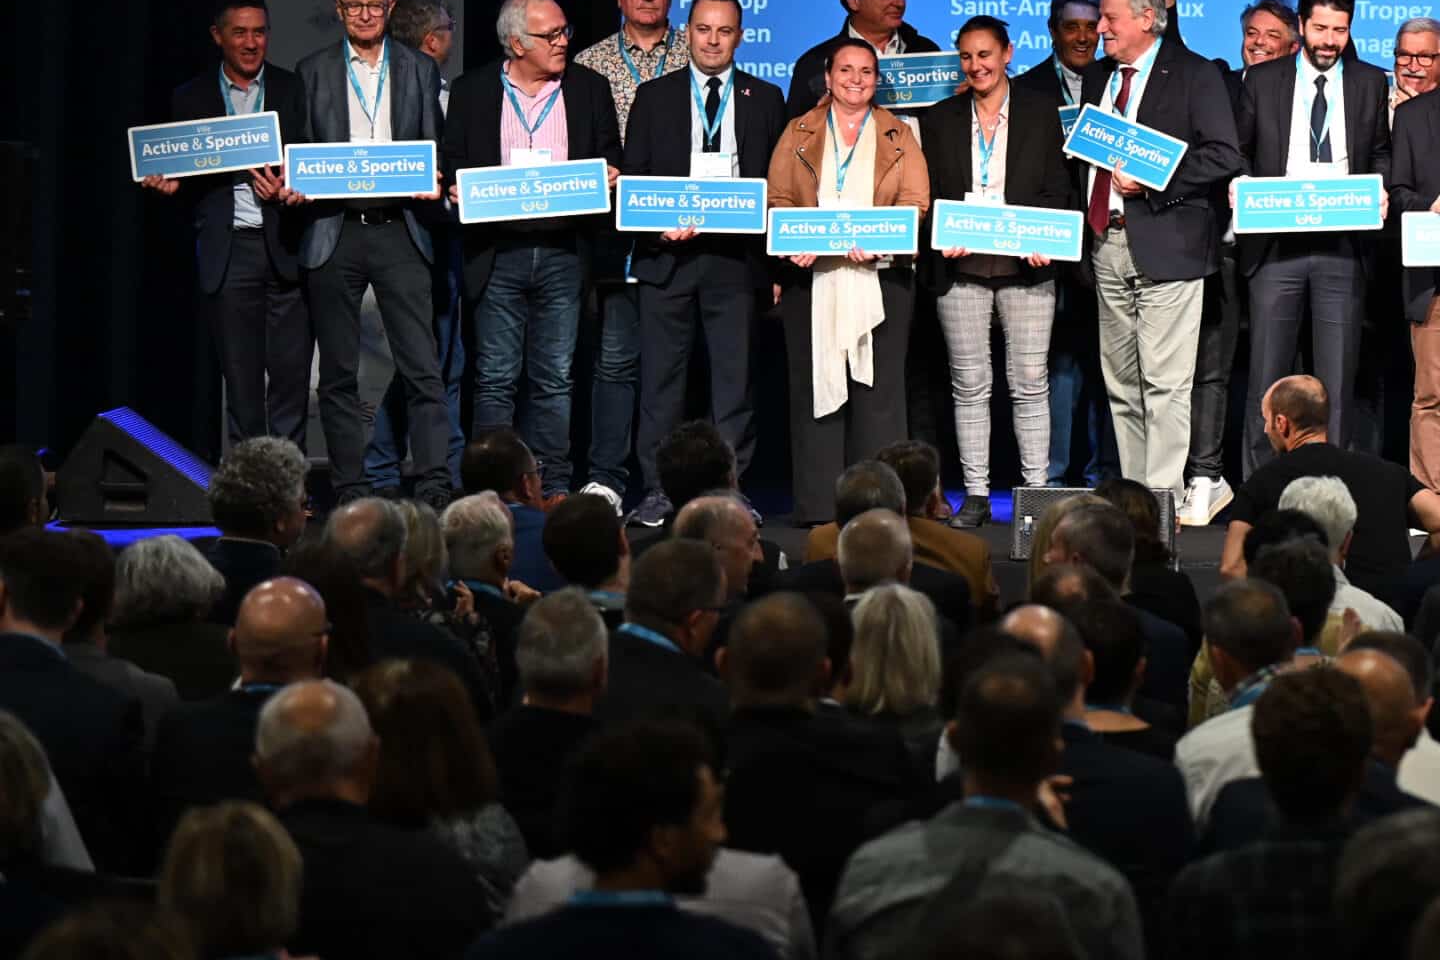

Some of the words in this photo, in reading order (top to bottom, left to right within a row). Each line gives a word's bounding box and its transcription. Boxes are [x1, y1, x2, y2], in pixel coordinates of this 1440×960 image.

[886, 70, 896, 84] &
[898, 67, 960, 87] Sportive
[142, 140, 189, 157] Active
[192, 137, 201, 151] &
[205, 130, 270, 154] Sportive
[1081, 122, 1116, 146] Active
[1116, 135, 1125, 149] &
[1125, 138, 1170, 167] Sportive
[297, 158, 344, 174] Active
[347, 159, 358, 173] &
[361, 158, 425, 177] Sportive
[470, 183, 518, 199] Active
[520, 182, 531, 195] &
[533, 177, 598, 198] Sportive
[628, 193, 675, 208] Active
[678, 194, 689, 208] &
[692, 194, 757, 213] Sportive
[1245, 194, 1292, 209] Active
[1295, 193, 1306, 208] &
[1309, 191, 1372, 212] Sportive
[779, 222, 826, 234] Active
[830, 221, 840, 234] &
[843, 220, 907, 238] Sportive
[944, 215, 992, 231] Active
[995, 217, 1006, 232] &
[1008, 218, 1072, 240] Sportive
